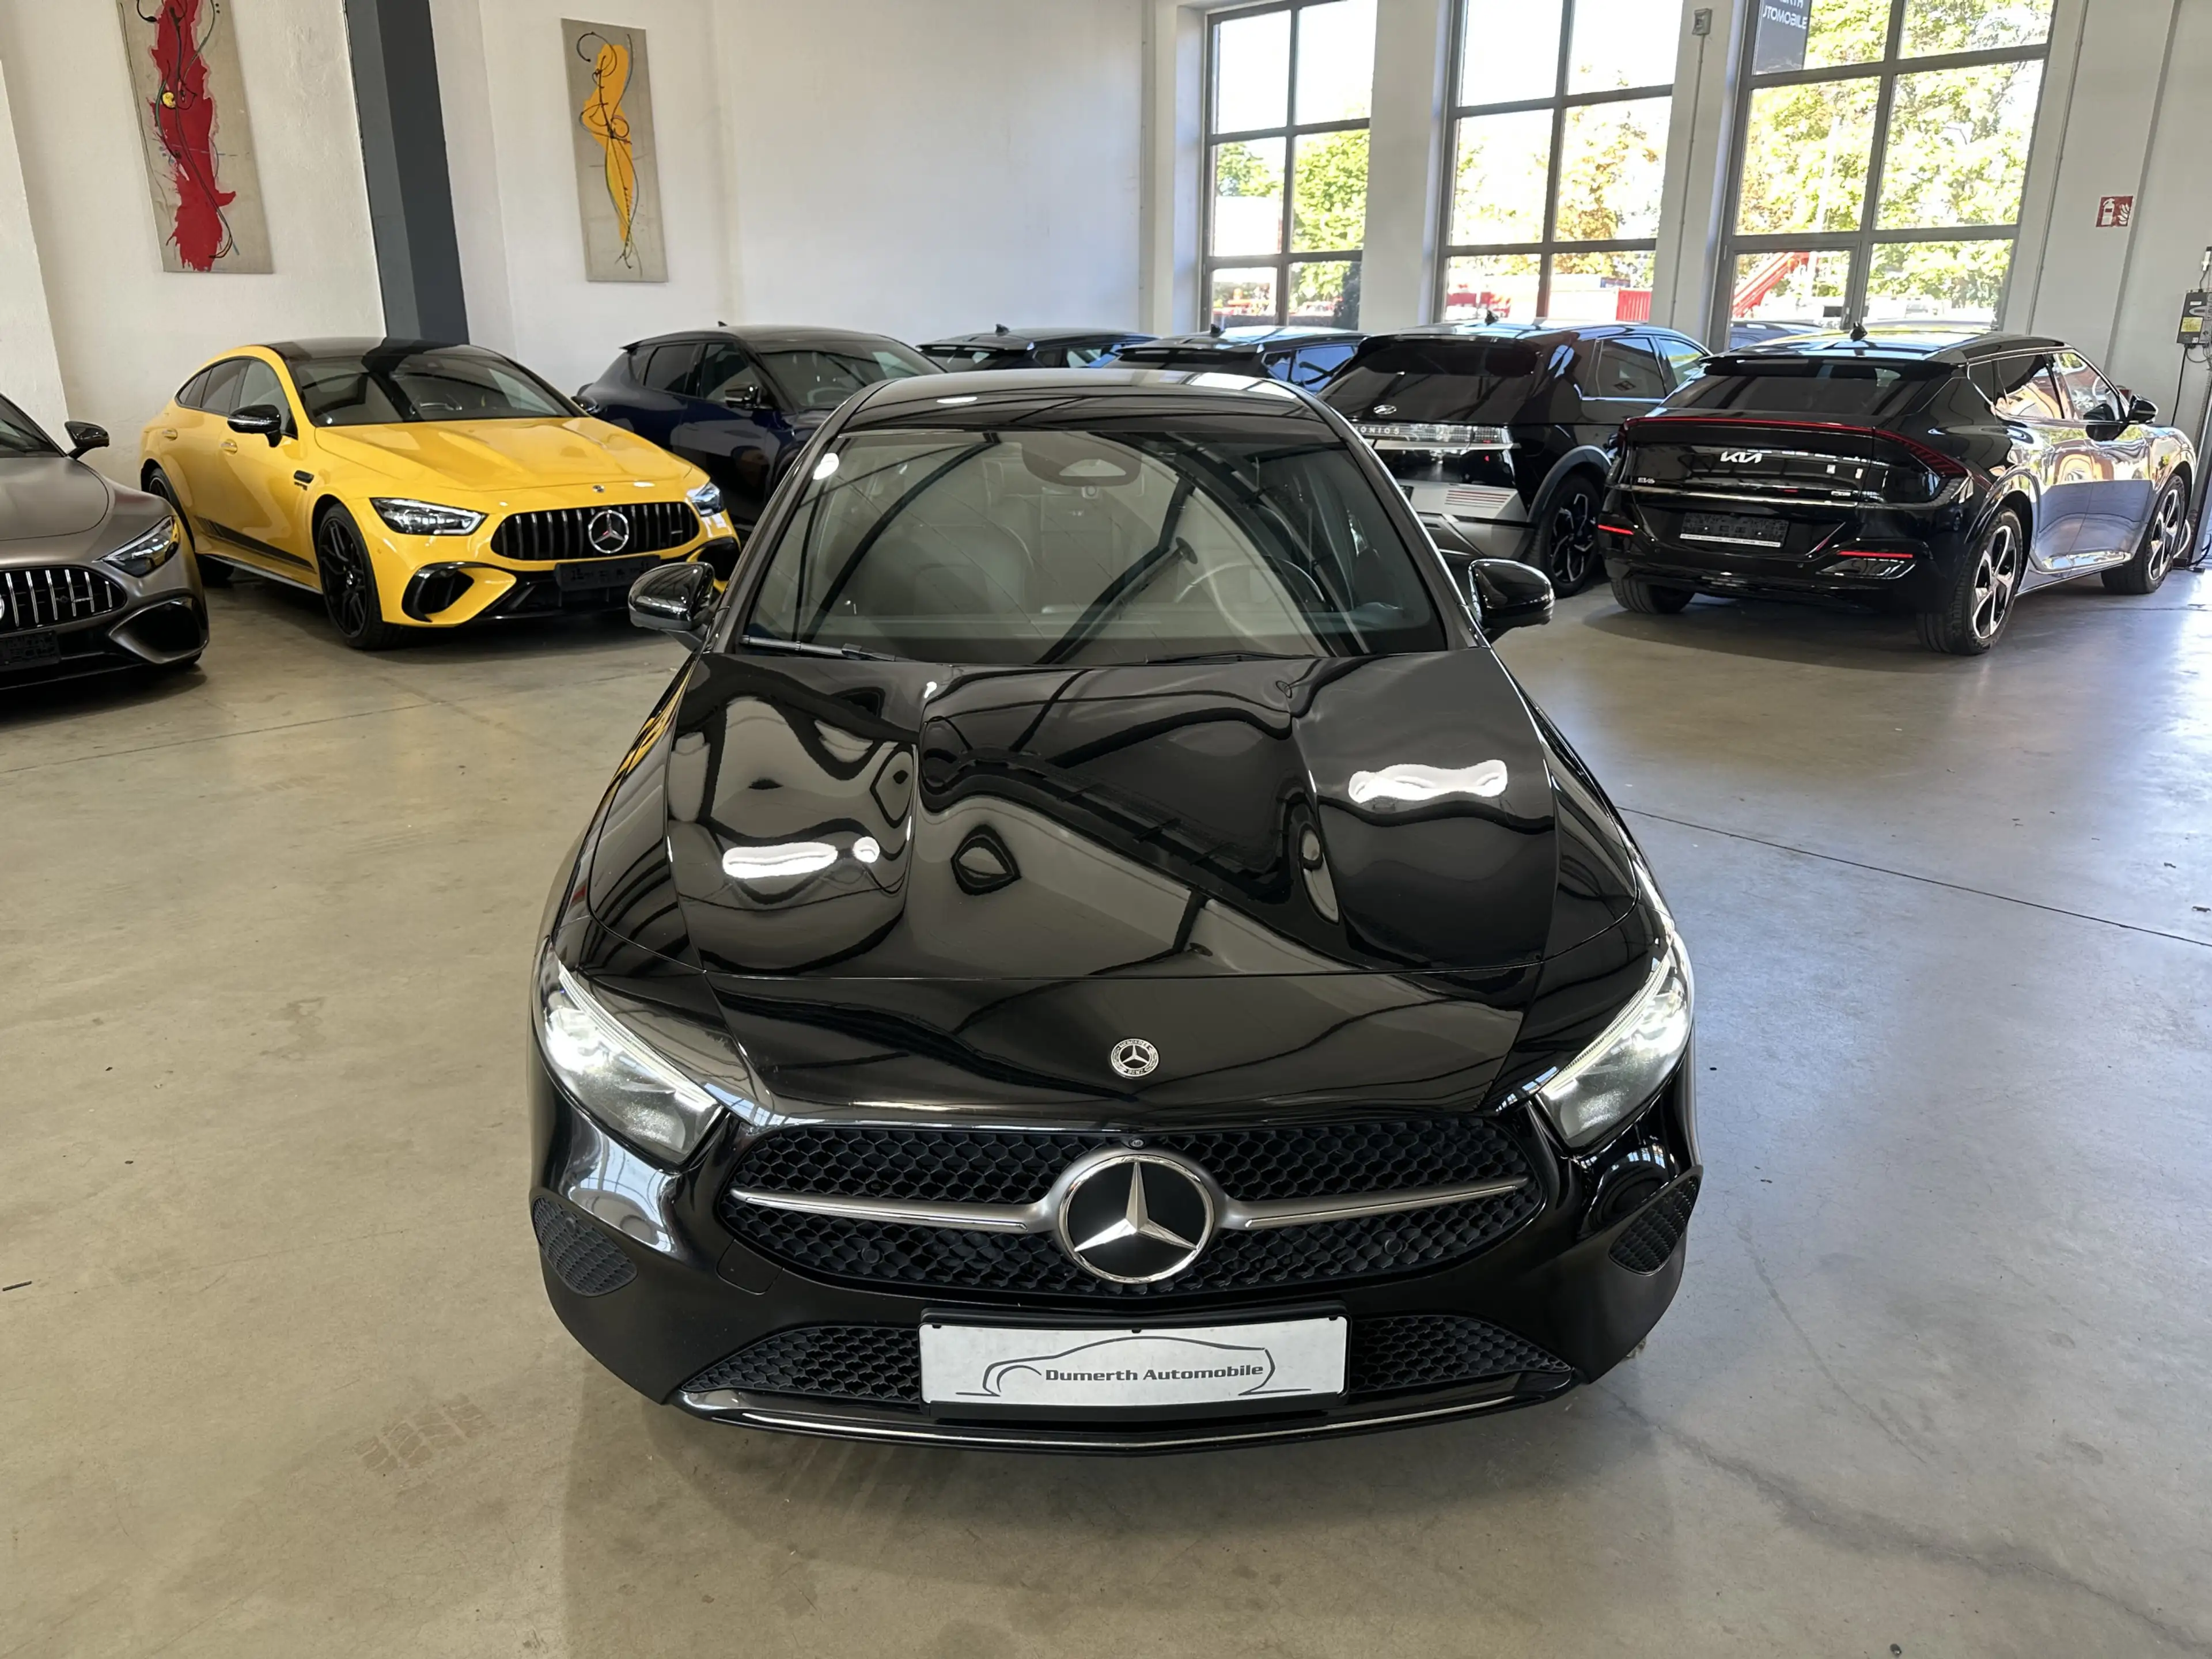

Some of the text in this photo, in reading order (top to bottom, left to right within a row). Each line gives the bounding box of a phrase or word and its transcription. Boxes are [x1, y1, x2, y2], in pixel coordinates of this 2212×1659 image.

[1720, 450, 1763, 464] KIA
[1046, 1365, 1263, 1381] Dumerth Automobile
